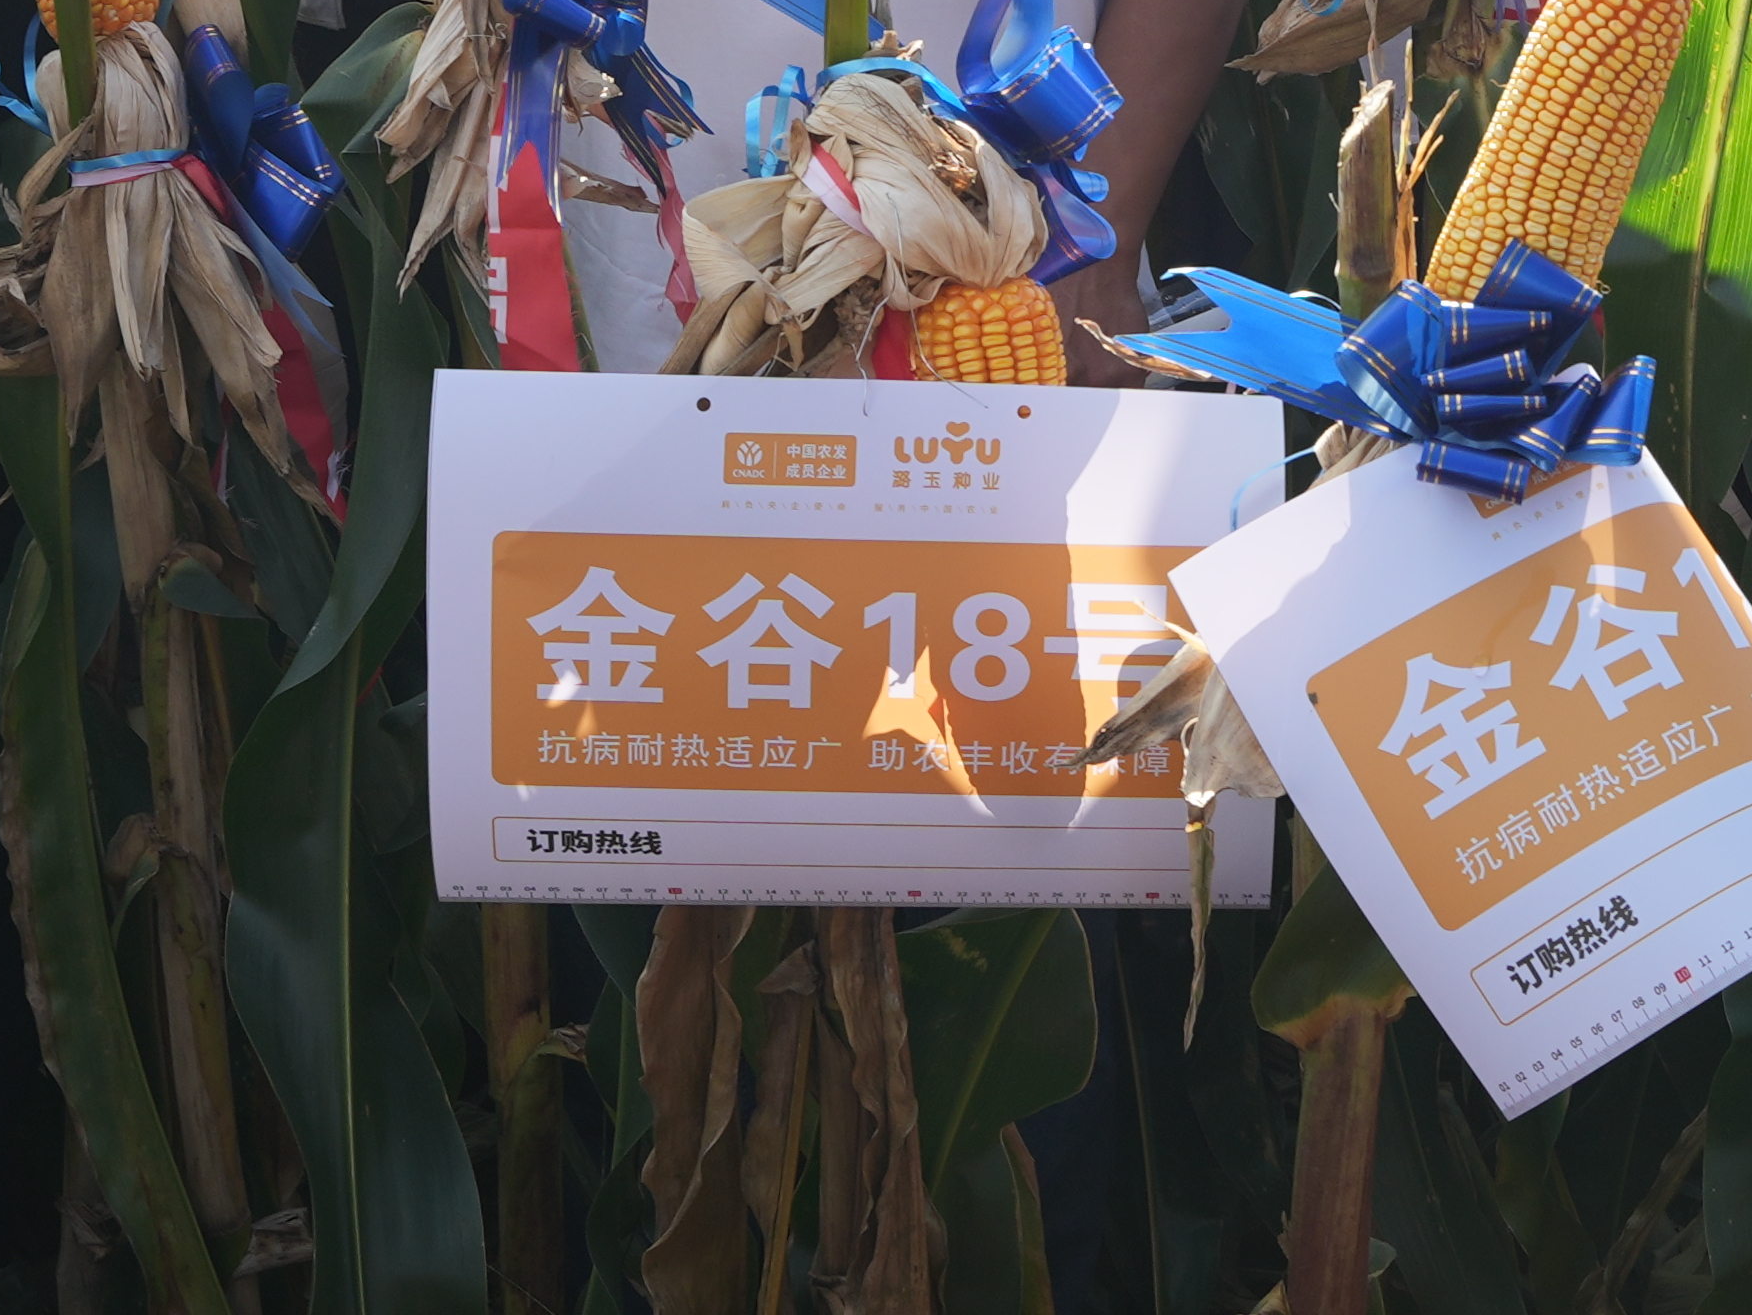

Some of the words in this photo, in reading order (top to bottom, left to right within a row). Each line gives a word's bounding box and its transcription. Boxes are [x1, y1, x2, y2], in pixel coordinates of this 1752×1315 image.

[786, 444, 847, 460] 中国农发
[894, 421, 1001, 464] LUYU
[732, 469, 765, 478] CNADC
[785, 463, 847, 479] 成员企业
[892, 470, 1000, 490] 潞玉种业
[526, 565, 1186, 711] 金谷18号
[537, 728, 844, 773] 抗病耐热适应广
[1455, 701, 1736, 888] 抗病耐热适应广
[526, 827, 663, 857] 订购热线
[1506, 894, 1639, 995] 订购热线
[1498, 1080, 1511, 1093] 01
[1514, 1071, 1527, 1083] 02
[1532, 1060, 1545, 1073] 03
[1550, 1048, 1563, 1061] 04
[1570, 1036, 1583, 1048] 05
[1591, 1023, 1604, 1036] 06
[1611, 1010, 1624, 1023] 07
[1632, 997, 1645, 1009] 08
[1654, 983, 1667, 995] 09
[1676, 968, 1689, 981] 10
[1699, 955, 1712, 968] 11
[1721, 941, 1734, 953] 12
